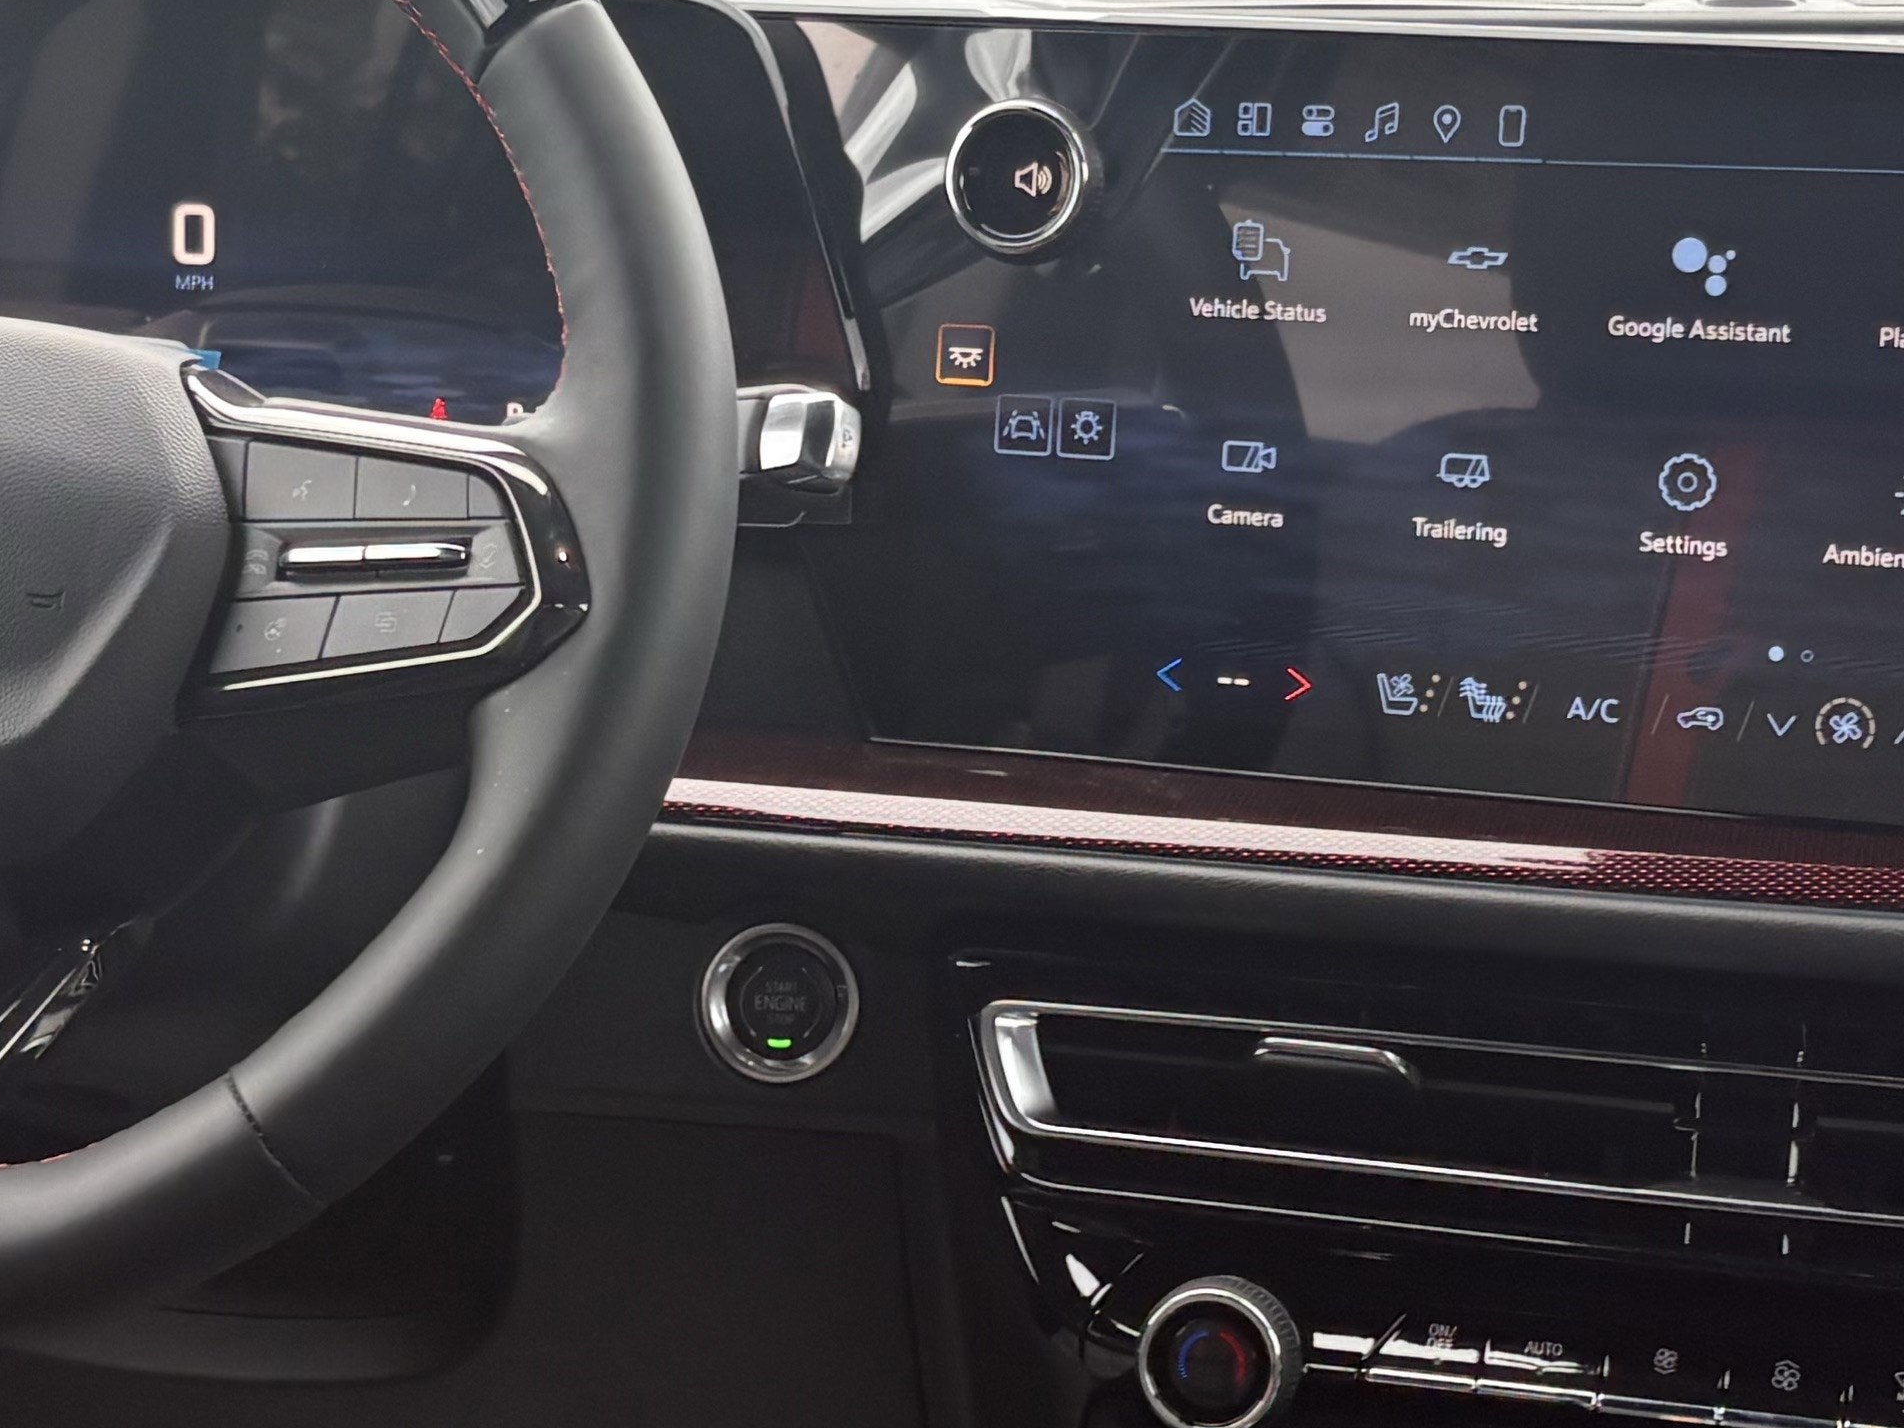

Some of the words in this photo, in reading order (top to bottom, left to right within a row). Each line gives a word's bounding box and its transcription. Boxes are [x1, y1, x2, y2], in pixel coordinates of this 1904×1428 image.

[174, 205, 214, 264] 0
[176, 275, 213, 289] MPH
[1190, 298, 1259, 319] Vehicle
[1265, 301, 1326, 322] Status
[1410, 309, 1537, 332] myChevrolet
[1609, 316, 1684, 342] Google
[1689, 320, 1790, 342] Assistant
[1208, 504, 1283, 527] Camera
[1413, 517, 1507, 547] Trailering
[1640, 532, 1727, 561] Settings
[1567, 697, 1618, 723] A/C
[1524, 1340, 1564, 1357] AUTO
